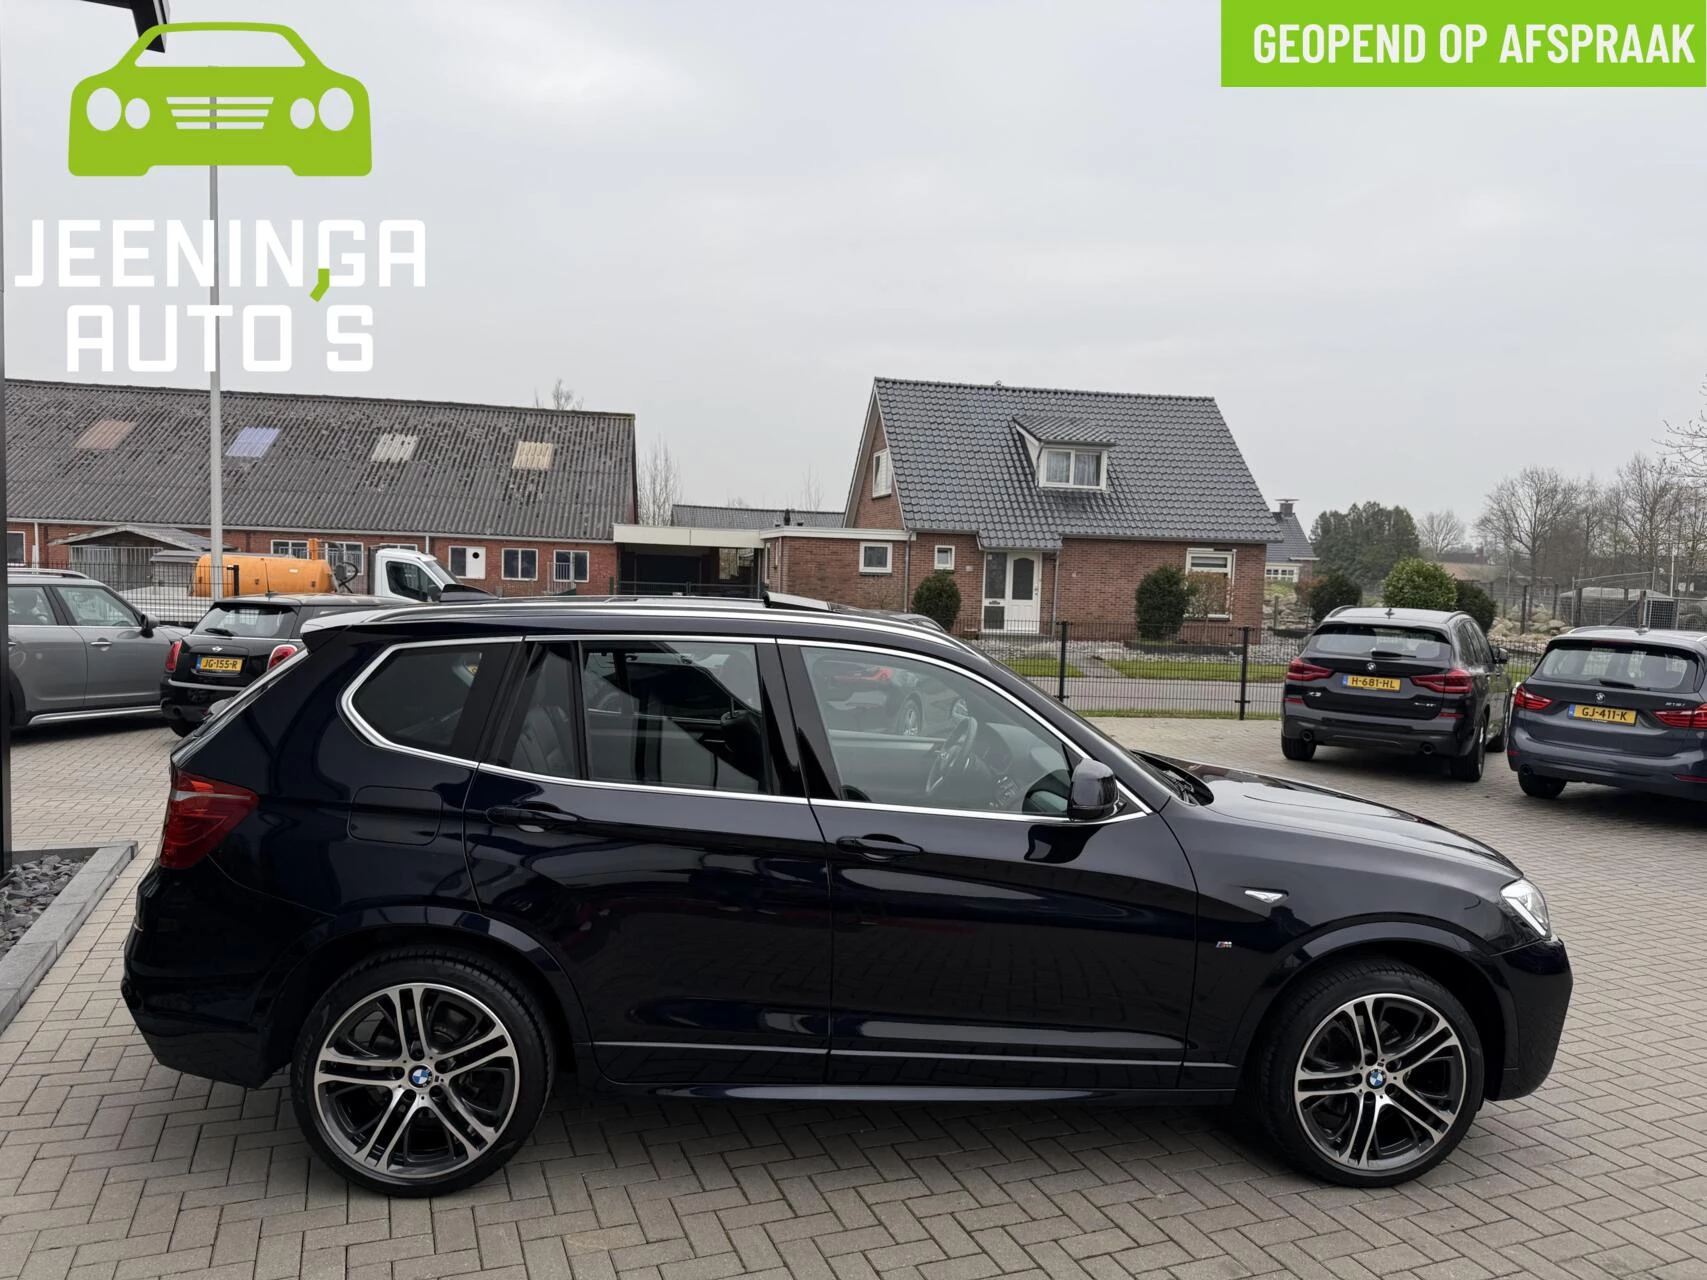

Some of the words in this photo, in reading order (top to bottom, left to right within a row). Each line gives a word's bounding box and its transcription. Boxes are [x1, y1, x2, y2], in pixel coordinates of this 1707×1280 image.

[202, 658, 238, 669] JG-155-R
[1351, 676, 1396, 689] H-681-HL
[1582, 707, 1627, 720] GJ-411-K
